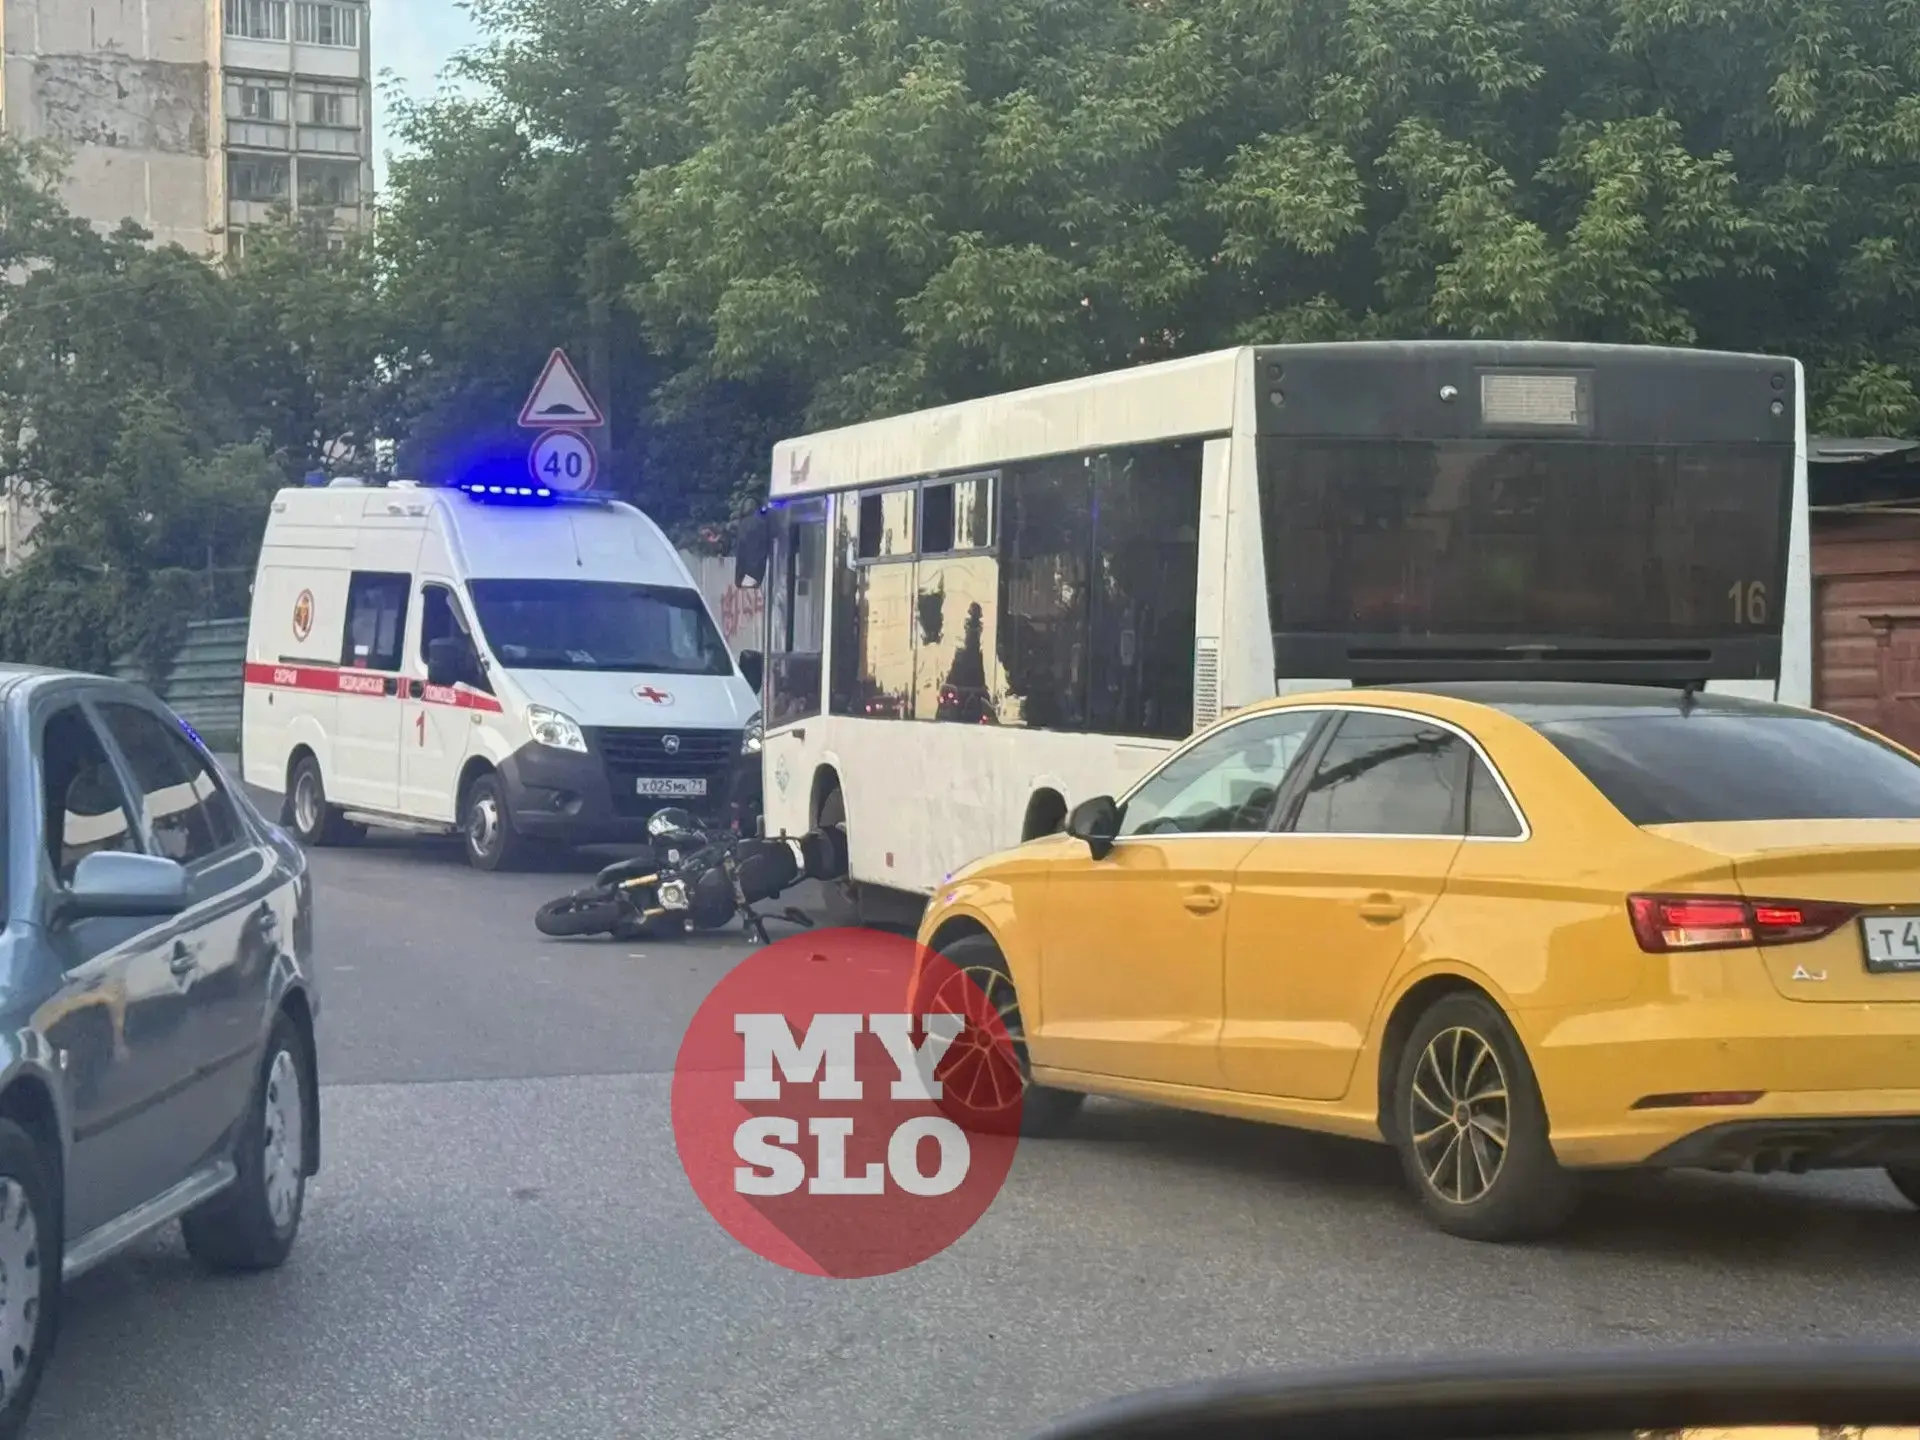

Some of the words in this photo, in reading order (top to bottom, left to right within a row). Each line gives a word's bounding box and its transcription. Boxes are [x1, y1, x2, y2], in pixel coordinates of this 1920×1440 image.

[543, 450, 583, 479] 40
[1728, 580, 1767, 625] 16
[416, 710, 425, 748] 1
[1878, 921, 1920, 955] Т4
